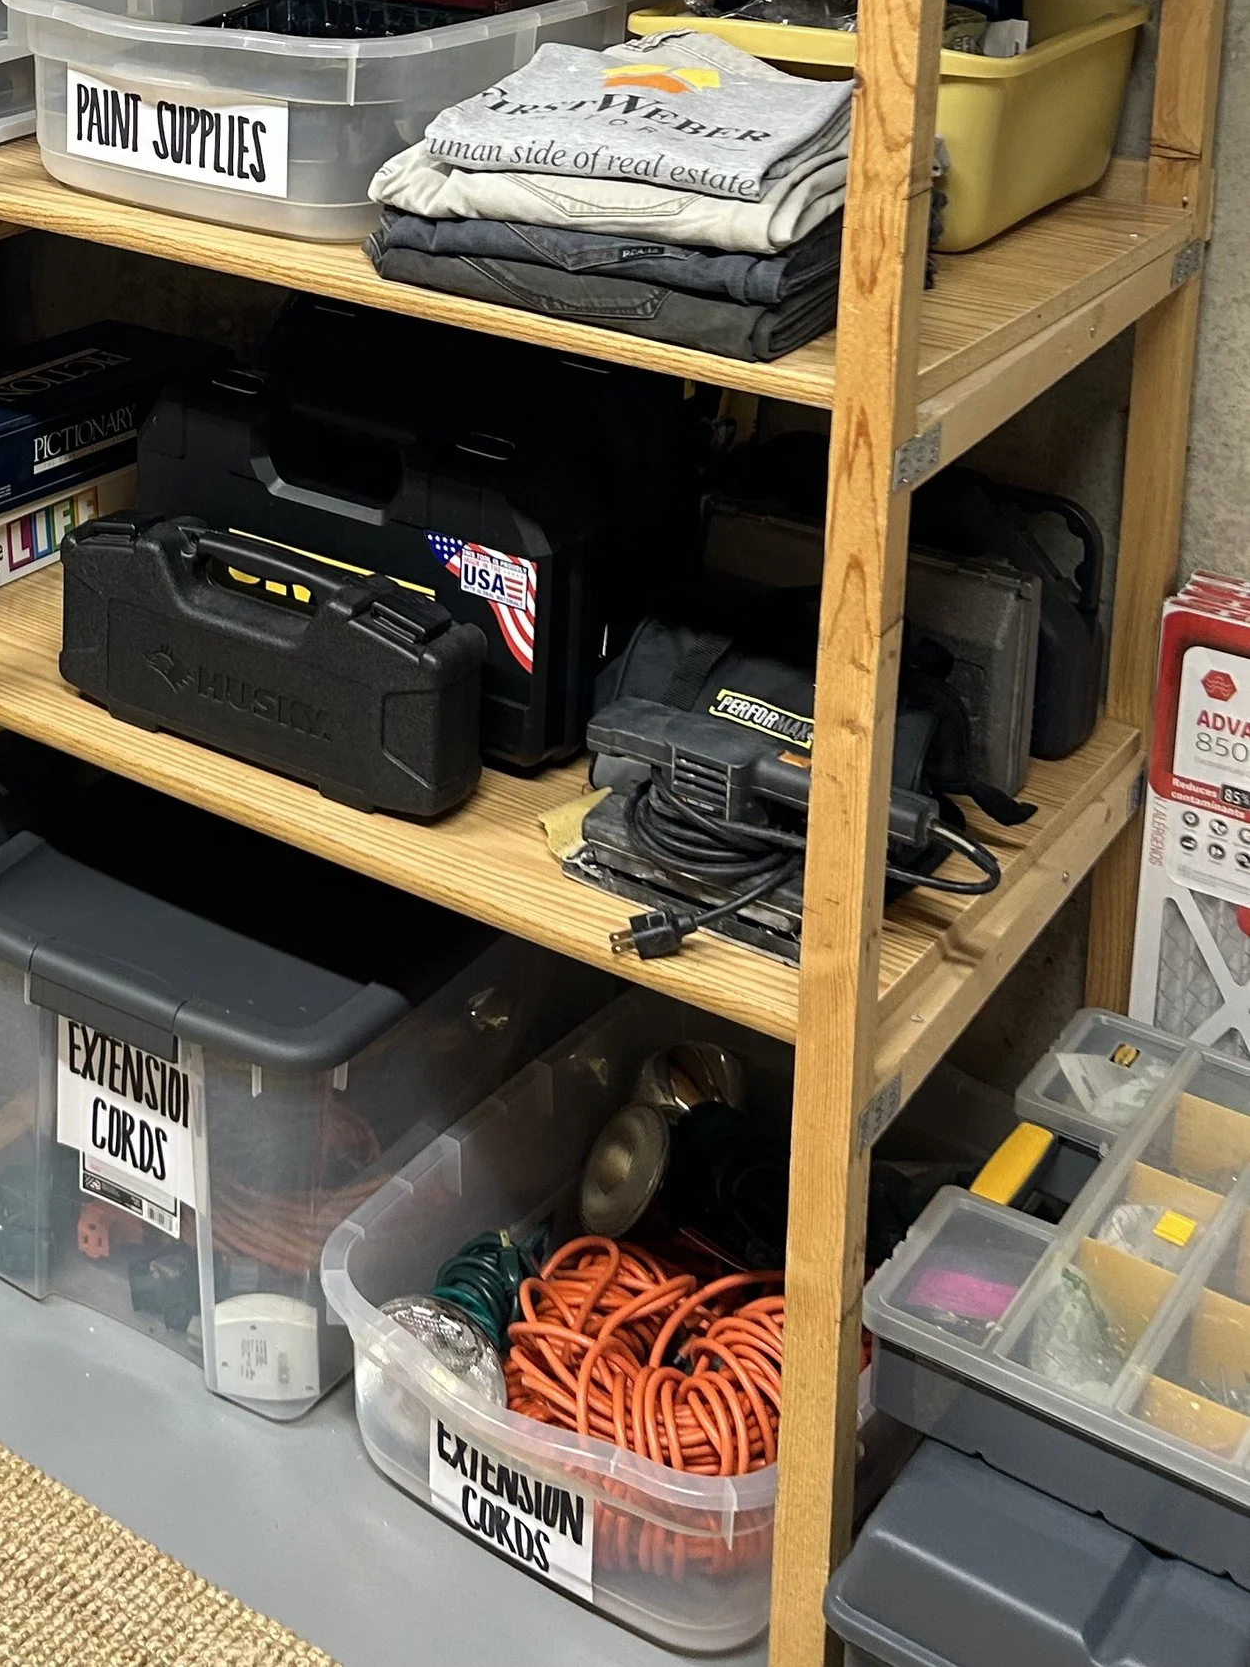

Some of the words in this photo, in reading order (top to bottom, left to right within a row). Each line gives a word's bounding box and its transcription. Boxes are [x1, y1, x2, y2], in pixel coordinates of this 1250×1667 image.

[77, 83, 142, 152] PAINT
[152, 100, 266, 183] SUPPLIES
[427, 136, 502, 162] uman
[509, 138, 565, 168] side
[574, 144, 608, 175] of
[608, 152, 665, 179] real
[33, 403, 136, 463] PICTIONARY
[8, 488, 98, 570] LIFE
[463, 563, 505, 597] USA
[1195, 732, 1249, 763] 850
[1171, 790, 1246, 819] contaminants
[1172, 777, 1218, 798] Reduces
[92, 1096, 168, 1181] CORDS
[462, 1484, 550, 1573] CORDS
